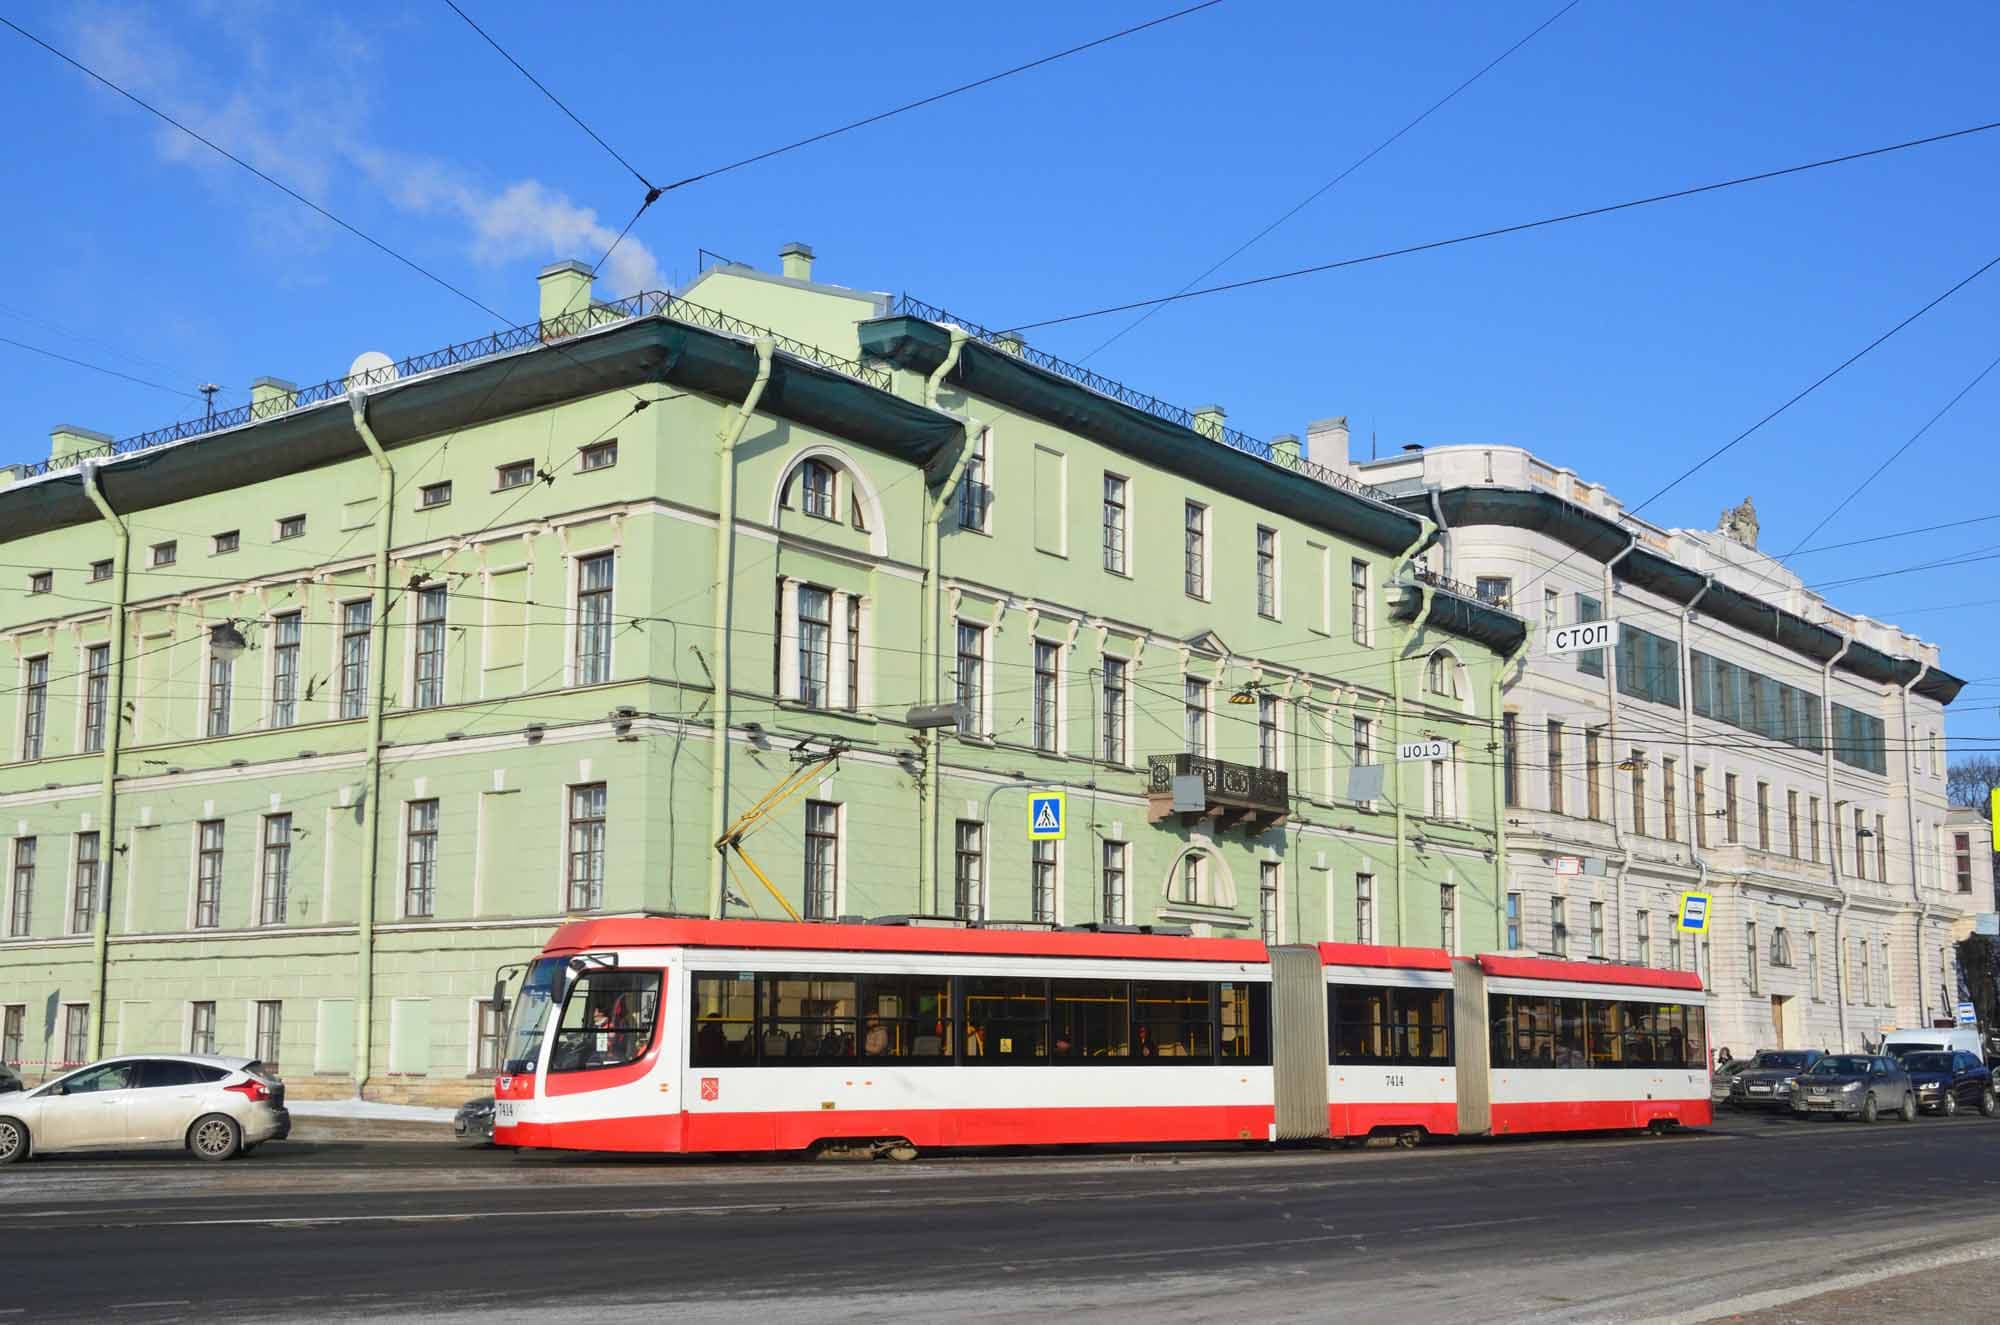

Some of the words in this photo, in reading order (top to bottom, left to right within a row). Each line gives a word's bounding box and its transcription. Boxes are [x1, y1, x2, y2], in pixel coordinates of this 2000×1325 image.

[1556, 625, 1608, 648] СТОП
[1385, 1075, 1404, 1087] 7414
[498, 1103, 513, 1117] 7414
